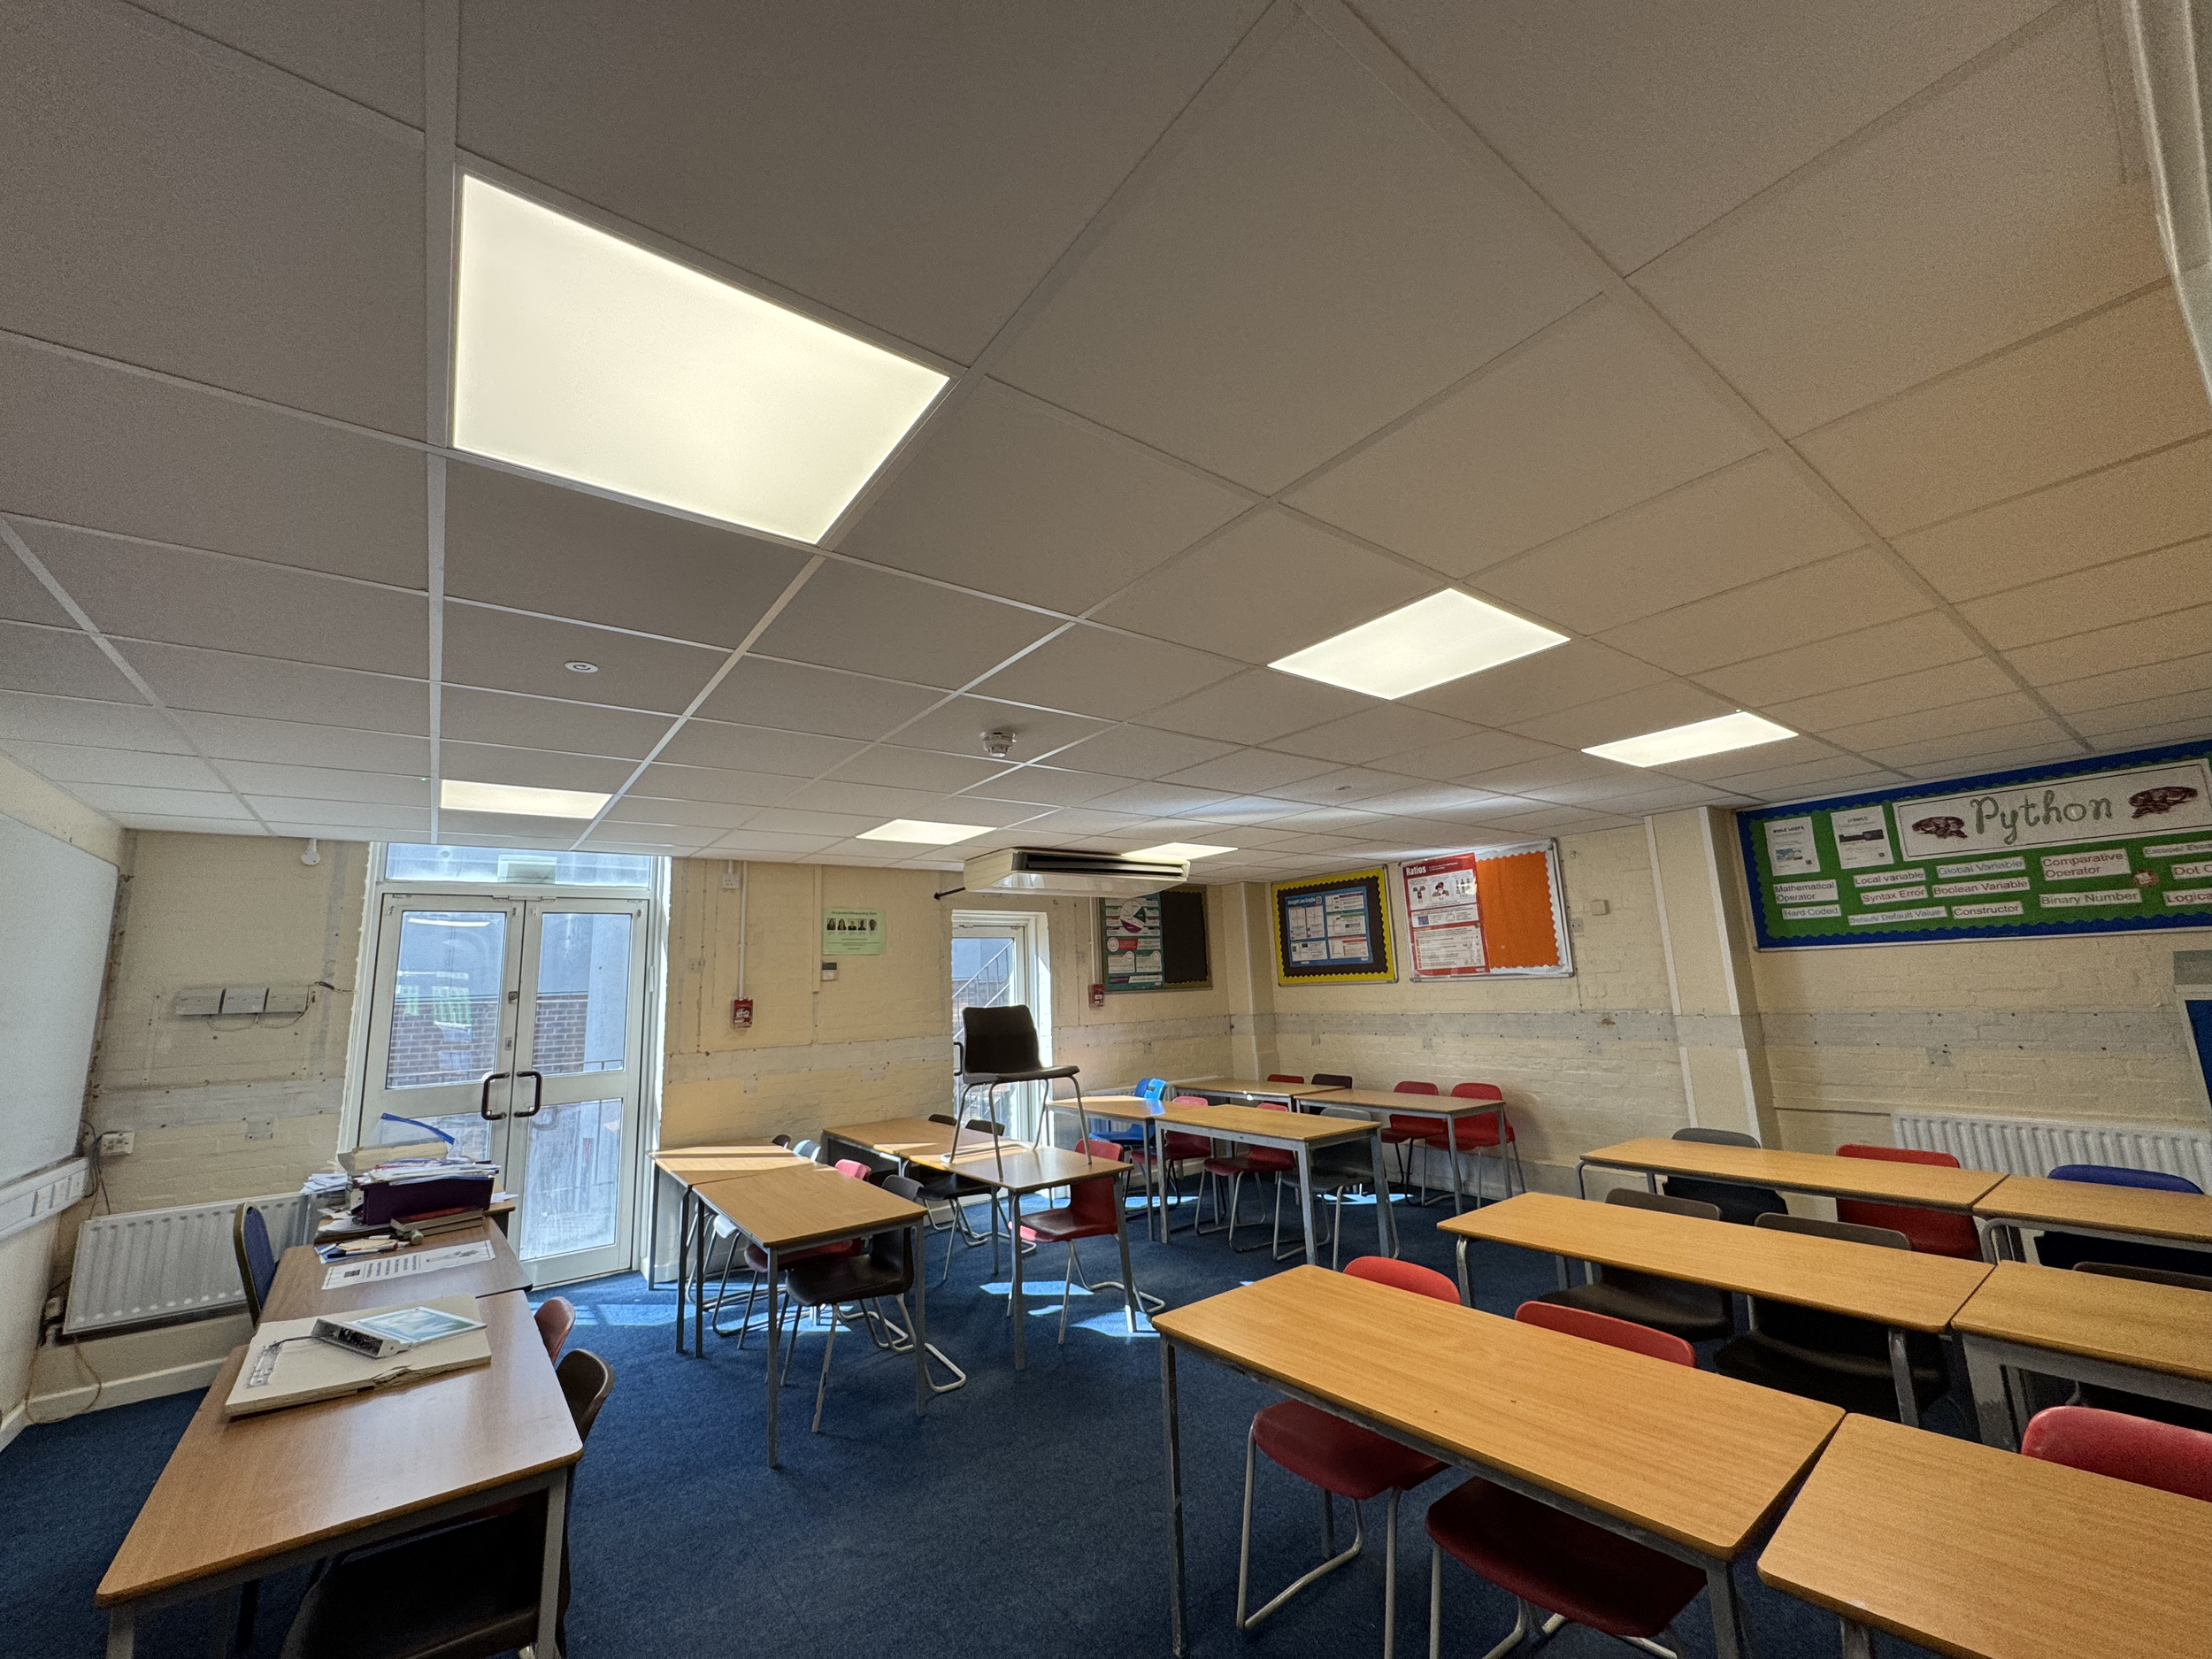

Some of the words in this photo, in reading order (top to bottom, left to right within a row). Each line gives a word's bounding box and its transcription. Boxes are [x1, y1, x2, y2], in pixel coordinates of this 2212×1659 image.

[1970, 790, 2113, 846] Python
[2043, 852, 2124, 867] Comparative
[1406, 865, 1426, 876] Ratios
[1938, 864, 1974, 875] Global
[1975, 859, 2024, 872] Variable
[2046, 865, 2101, 879] Operator
[2174, 866, 2200, 876] Dot
[1855, 874, 1882, 885] Local
[1883, 872, 1924, 883] variable
[1775, 882, 1835, 894] Mathematical
[1933, 885, 1978, 895] Boolean
[1981, 880, 2028, 891] Variable
[1777, 893, 1816, 903] Operator
[1863, 892, 1897, 904] Syntax
[1899, 888, 1925, 898] Error
[2041, 895, 2081, 907] Binary
[2085, 892, 2139, 902] Number
[1784, 909, 1806, 918] Hard
[1808, 907, 1839, 917] Coded
[1954, 904, 2019, 917] Constructor
